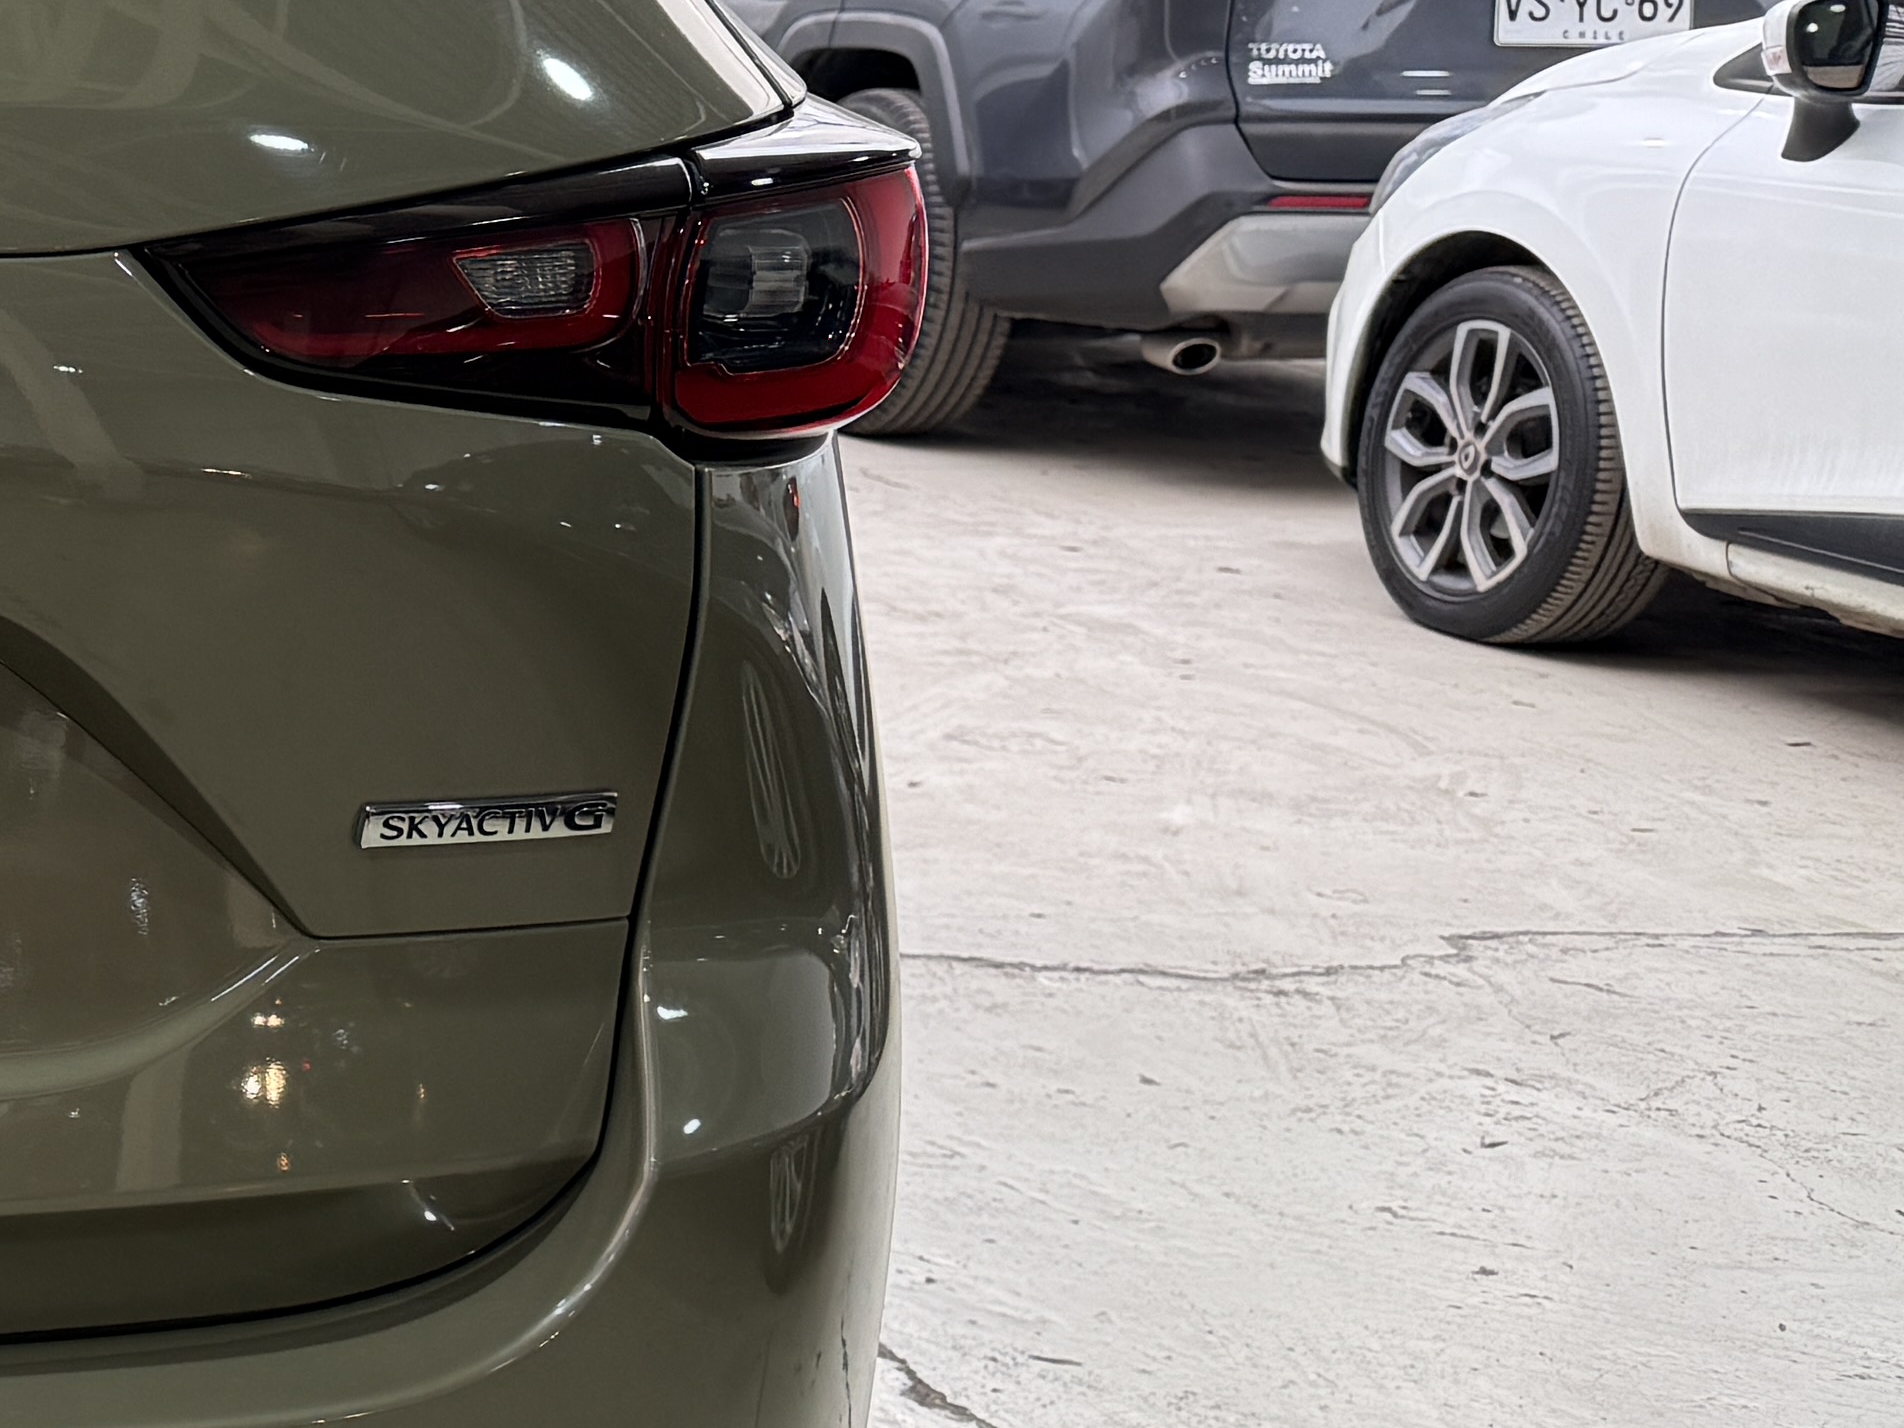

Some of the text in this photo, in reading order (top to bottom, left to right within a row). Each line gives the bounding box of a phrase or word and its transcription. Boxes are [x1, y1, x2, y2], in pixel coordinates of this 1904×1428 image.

[1562, 29, 1625, 41] CHILE
[1247, 42, 1327, 59] TOYOTA
[1248, 59, 1333, 79] Summit
